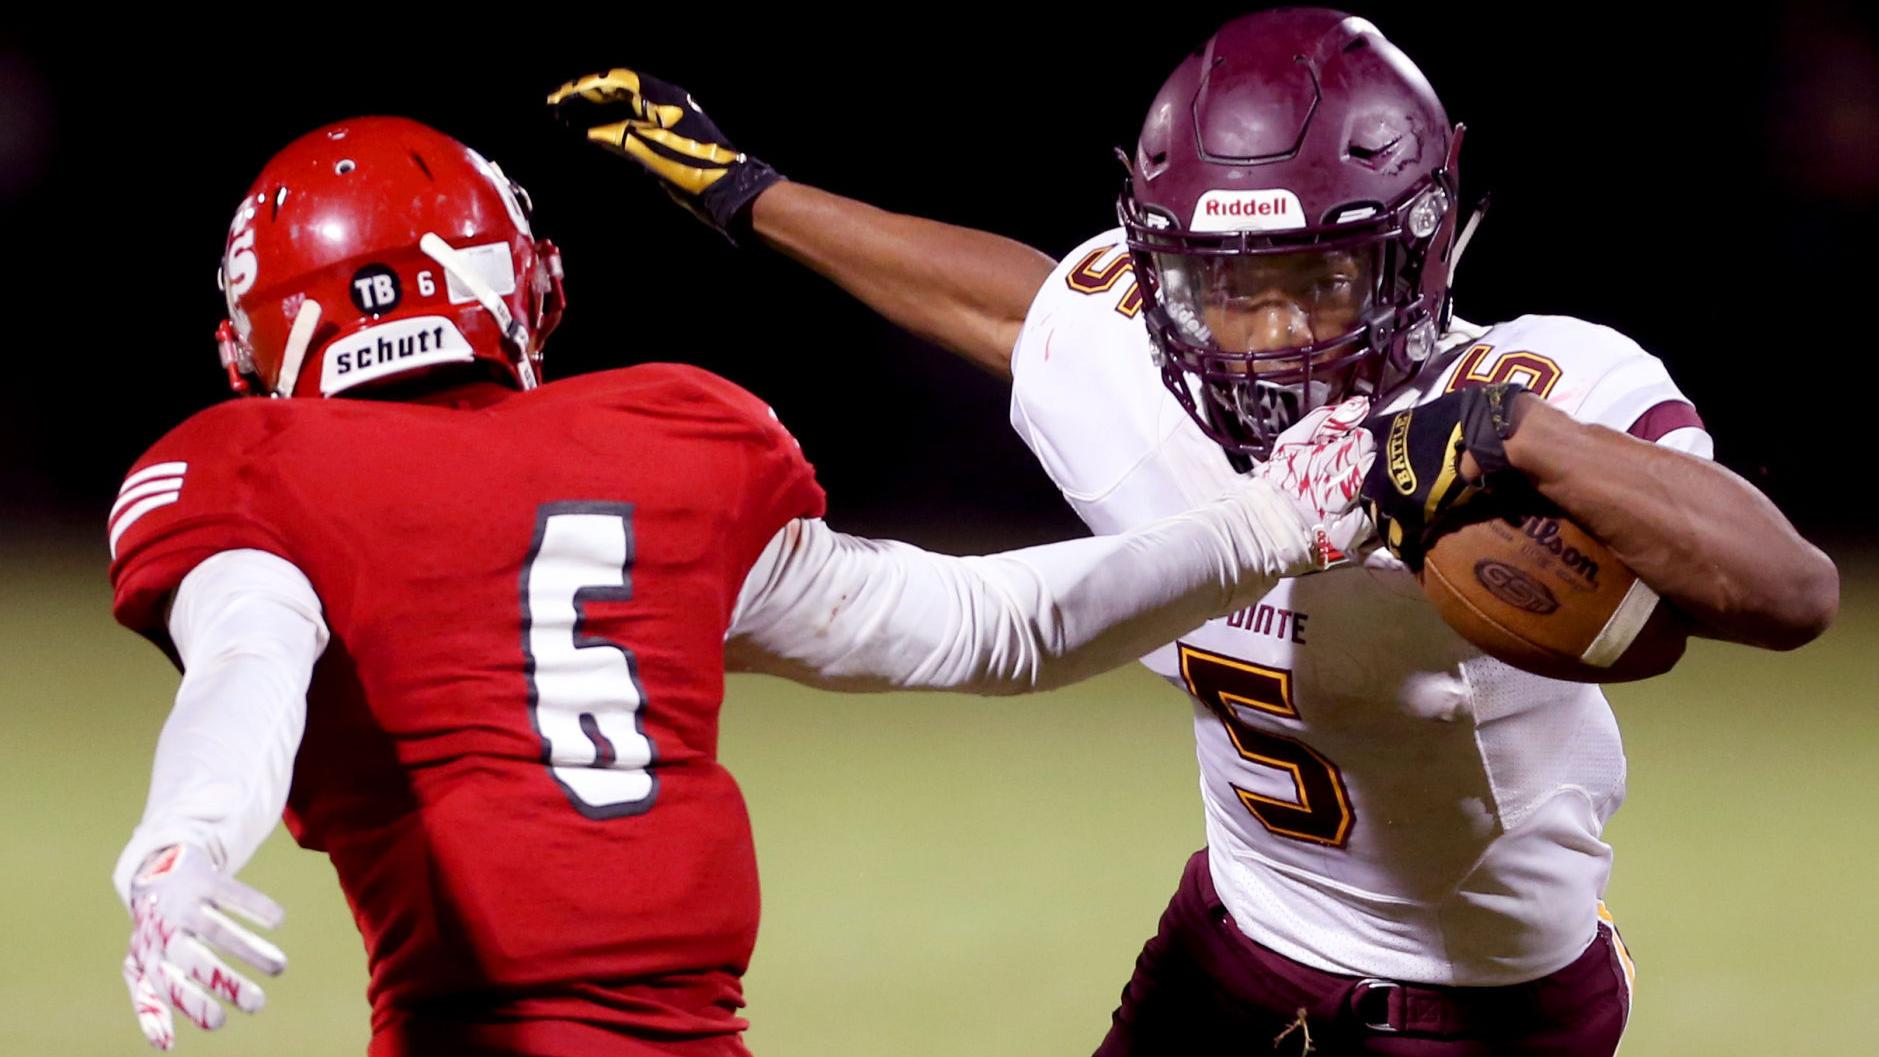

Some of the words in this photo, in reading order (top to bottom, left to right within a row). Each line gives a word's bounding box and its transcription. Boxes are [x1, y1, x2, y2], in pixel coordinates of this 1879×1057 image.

[1205, 197, 1287, 216] Riddell
[354, 273, 395, 309] TB
[416, 270, 436, 297] 6
[337, 326, 444, 375] schutt
[1391, 415, 1412, 486] BATTLE
[1524, 515, 1599, 588] ilson
[1227, 602, 1309, 645] OINTE
[519, 501, 660, 820] 6
[1177, 640, 1358, 850] 5
